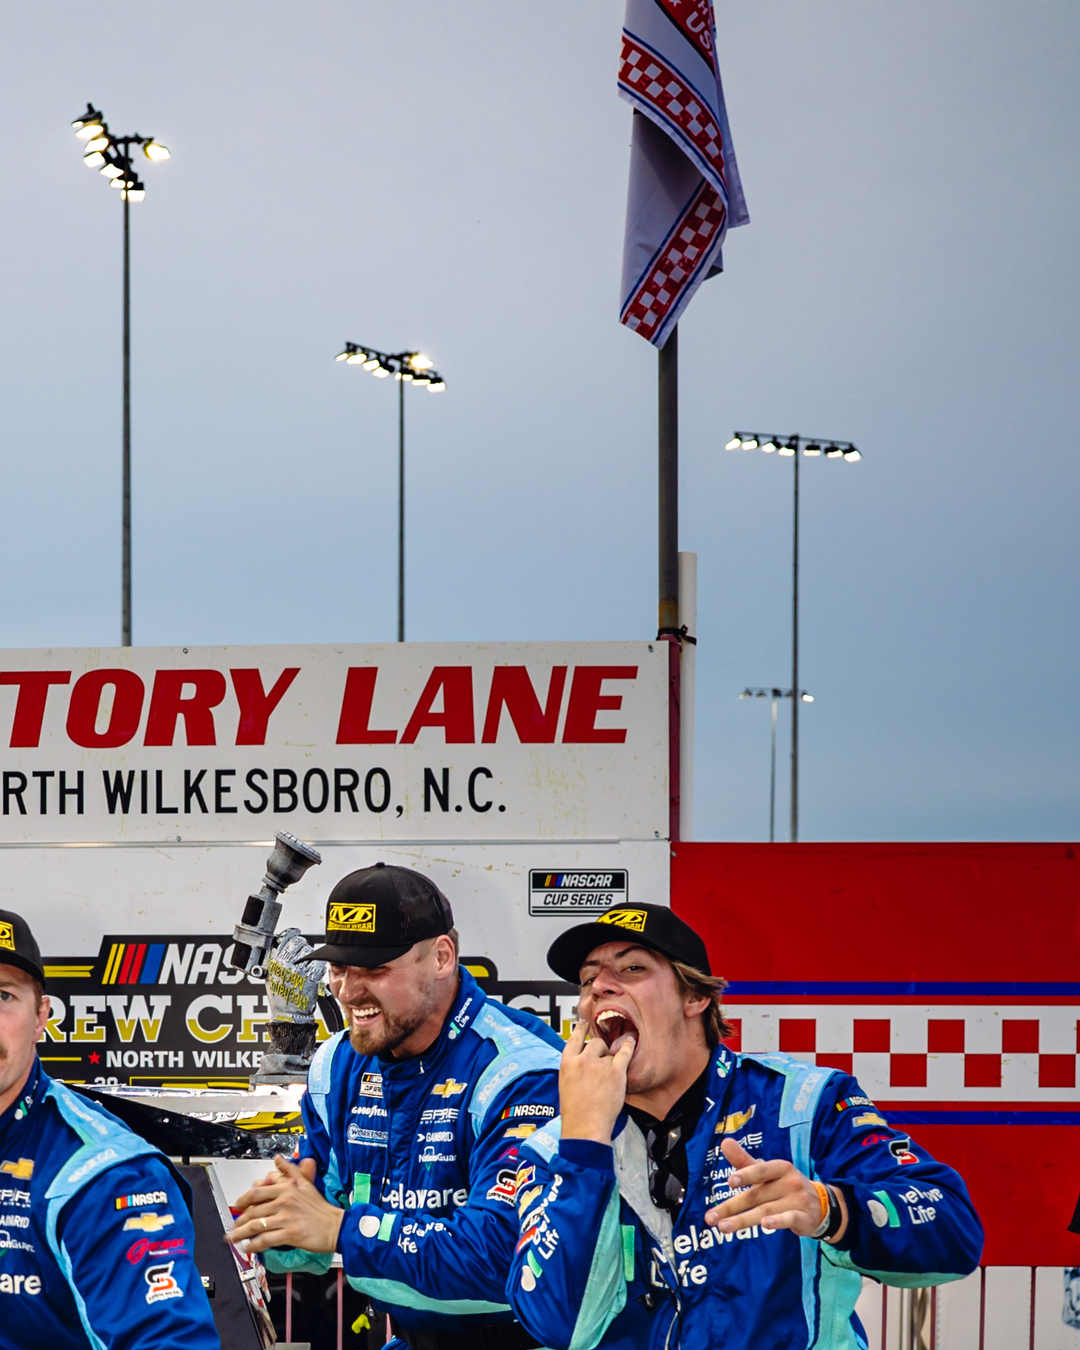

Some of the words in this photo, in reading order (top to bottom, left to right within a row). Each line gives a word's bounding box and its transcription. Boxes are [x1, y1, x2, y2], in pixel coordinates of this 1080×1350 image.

[336, 666, 638, 744] LANE
[102, 767, 404, 818] WILKESBORO,
[423, 766, 507, 813] N.C.
[561, 874, 613, 888] NASCAR
[543, 893, 569, 906] CUP
[570, 893, 614, 905] SERIES
[106, 1051, 183, 1067] NORTH
[514, 1104, 555, 1117] NASCAR
